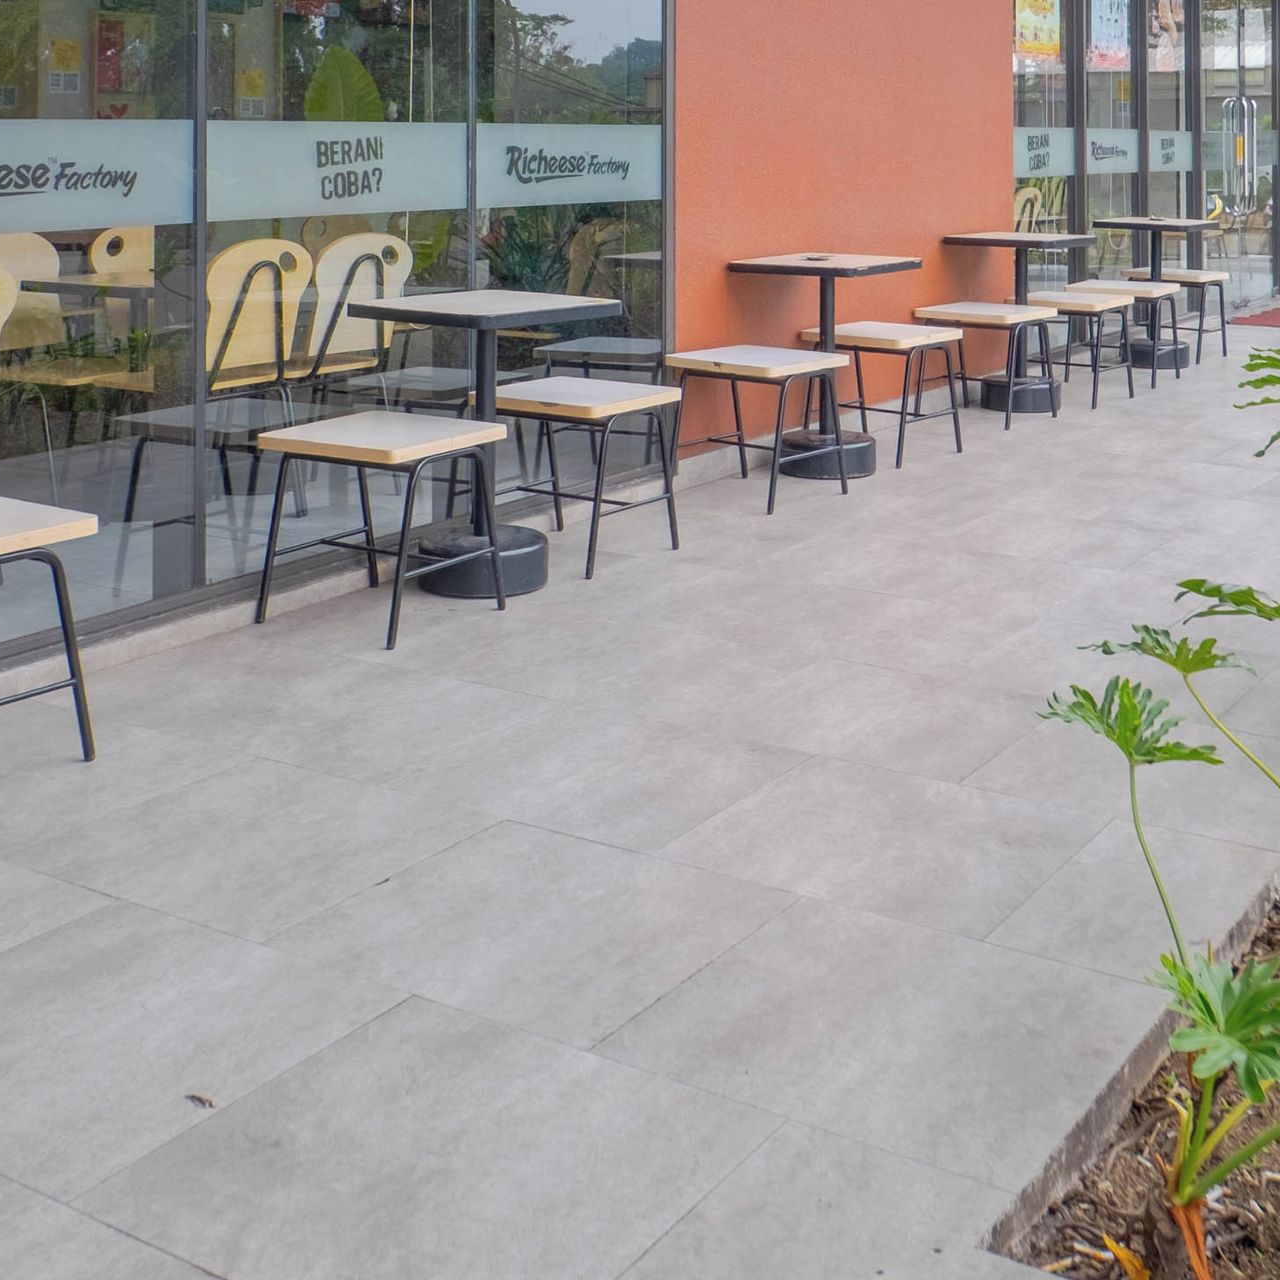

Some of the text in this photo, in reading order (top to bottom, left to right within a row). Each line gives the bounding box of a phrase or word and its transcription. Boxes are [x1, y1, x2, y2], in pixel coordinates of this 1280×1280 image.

[316, 136, 384, 168] BERANI
[1027, 133, 1050, 152] BERANI
[506, 145, 630, 184] Richeese Factory
[1029, 152, 1050, 171] COBA?
[54, 162, 138, 197] Factory
[321, 167, 383, 200] COBA?
